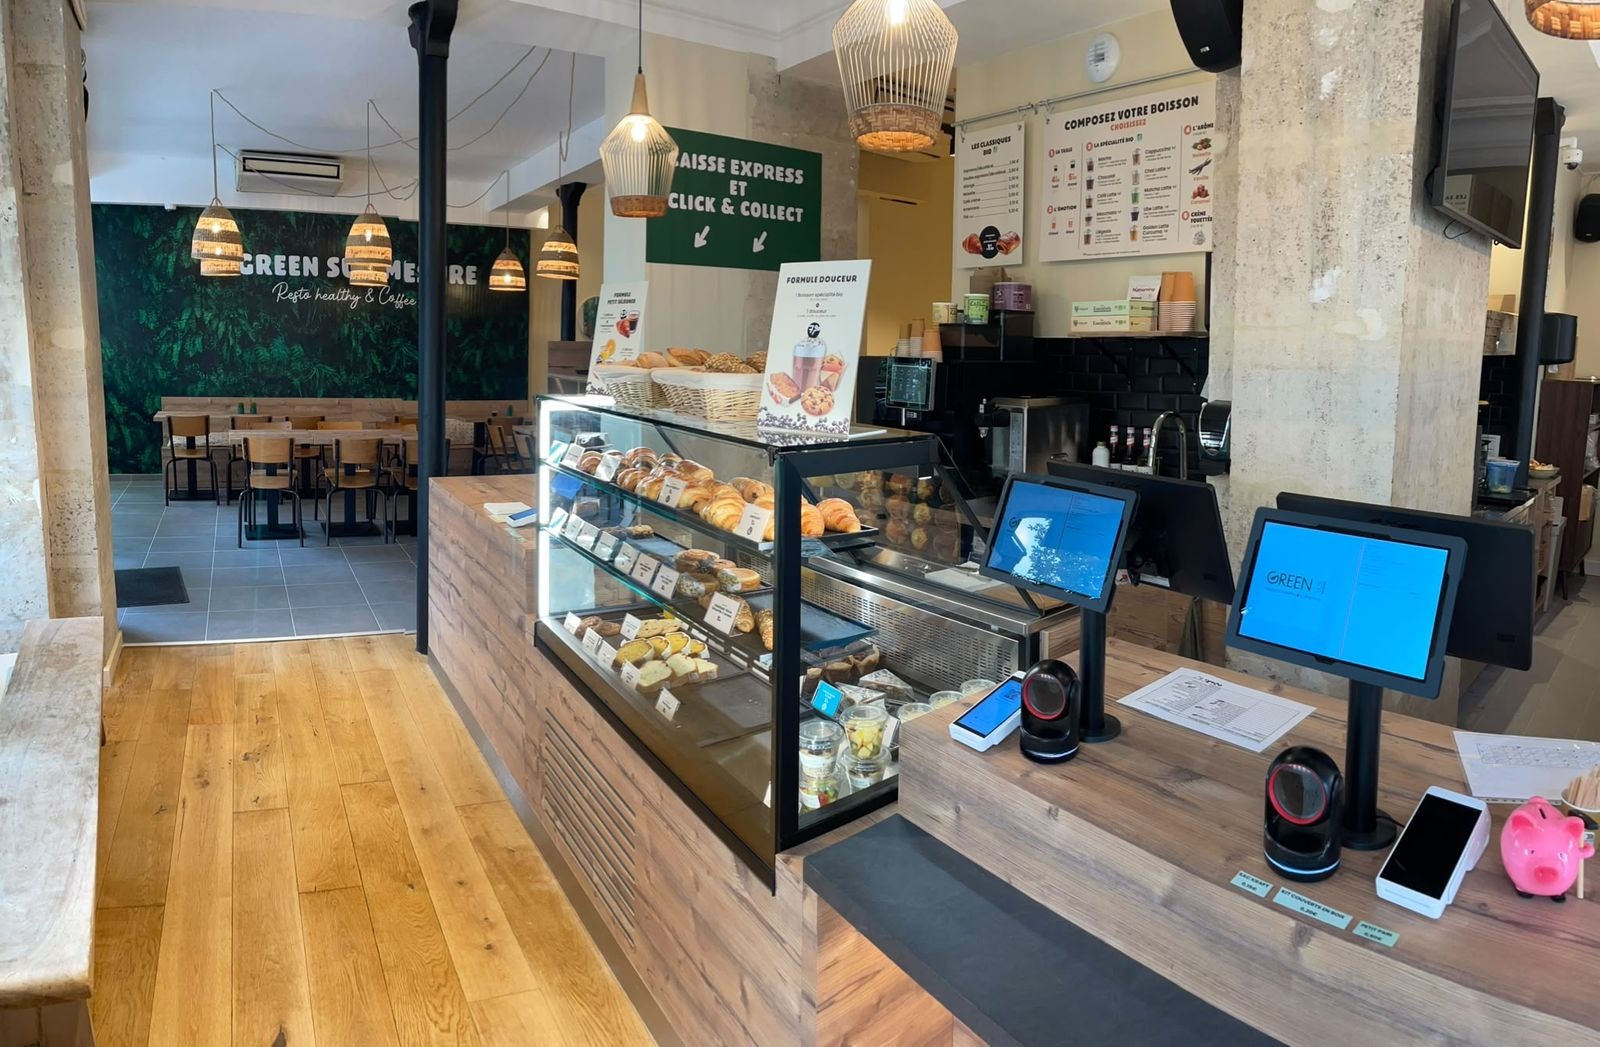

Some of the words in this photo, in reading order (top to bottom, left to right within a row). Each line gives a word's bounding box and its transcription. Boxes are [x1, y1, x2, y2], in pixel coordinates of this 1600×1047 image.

[1064, 112, 1115, 131] COMPOSEZ
[1118, 105, 1149, 120] VOTRE
[1150, 96, 1199, 114] BOISSON
[1110, 118, 1147, 131] CHOISISSEZ
[971, 142, 980, 150] LES
[980, 136, 1011, 148] CLASSIQUES
[675, 151, 726, 173] AISSE
[730, 159, 804, 184] EXPRESS
[729, 180, 747, 196] ET
[668, 193, 716, 213] CLICK
[721, 198, 735, 215] &
[740, 201, 804, 223] COLLECT
[240, 253, 319, 277] GREEN
[786, 276, 818, 284] FORMULE
[820, 275, 857, 283] DOUCEUR
[271, 281, 311, 303] Resto
[316, 289, 360, 309] healthy
[364, 287, 375, 303] &
[378, 285, 417, 309] Coffee
[1266, 570, 1313, 592] GREEN
[1251, 876, 1270, 888] KRAFT
[1291, 894, 1321, 911] COUVERTS
